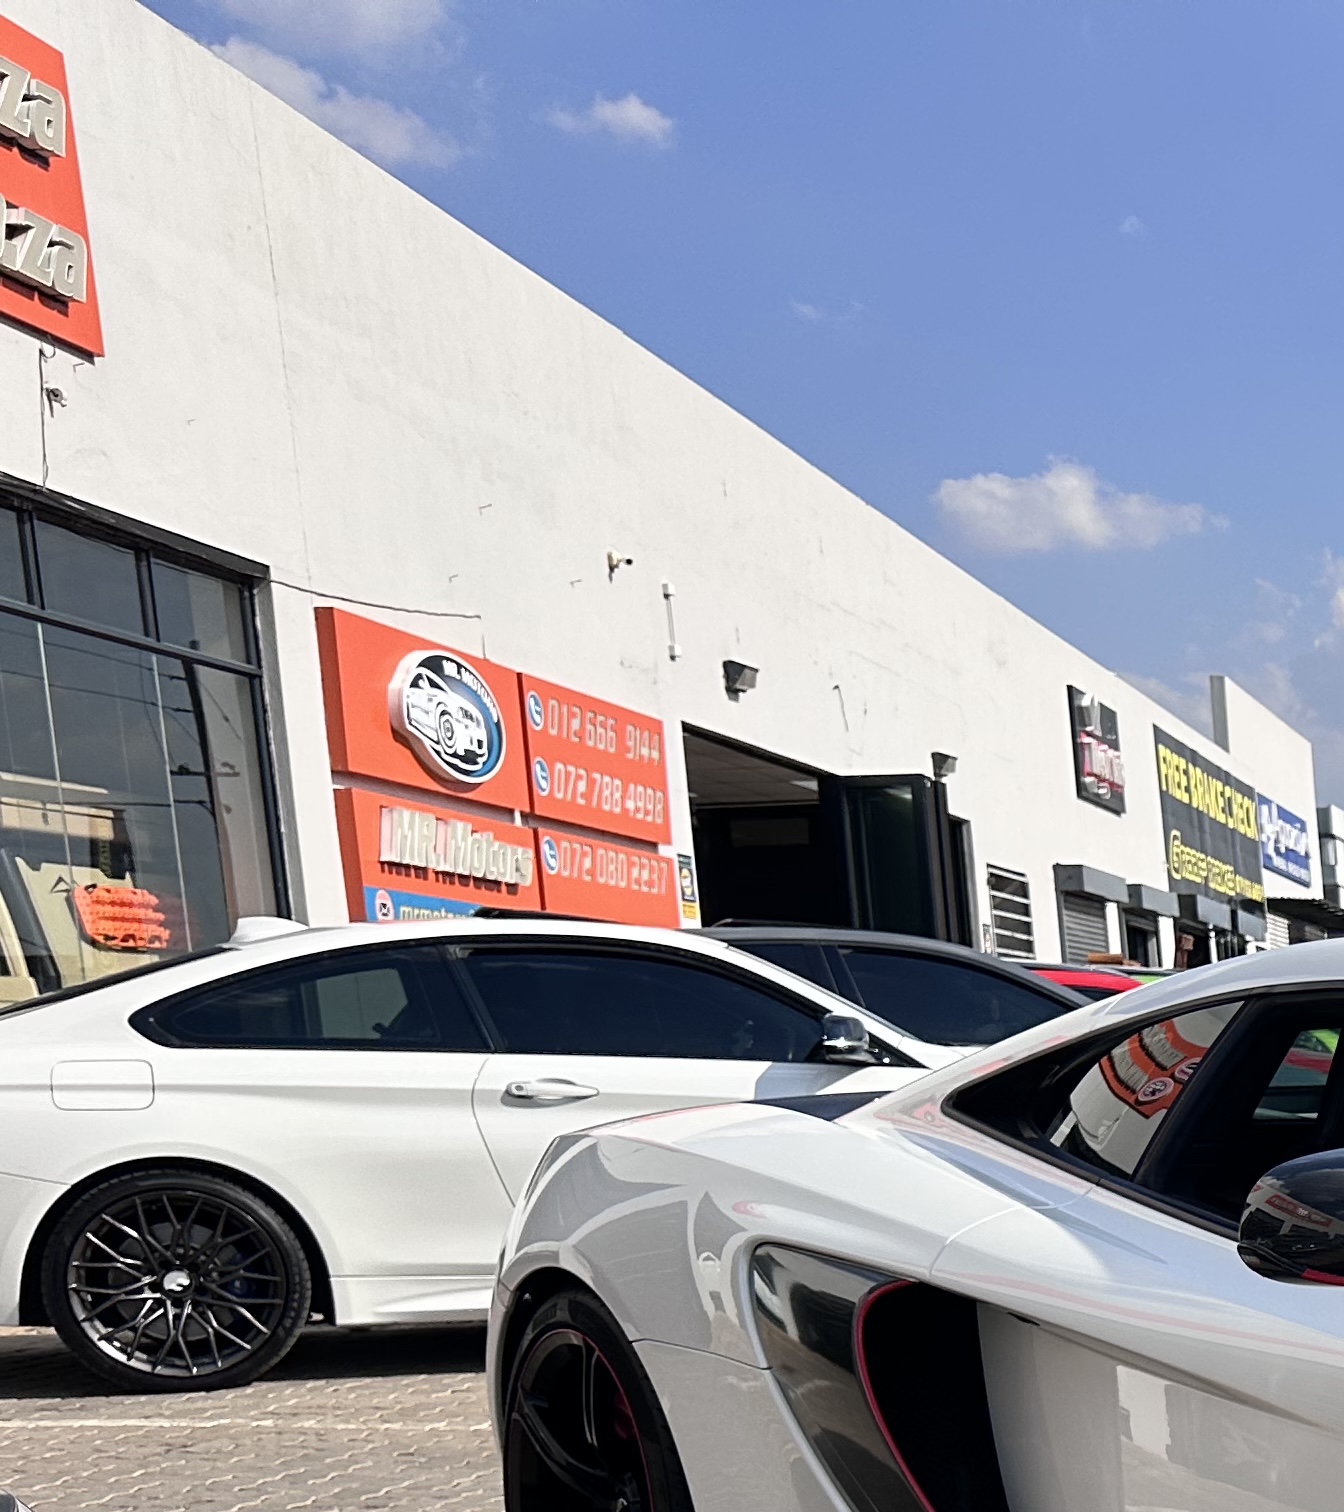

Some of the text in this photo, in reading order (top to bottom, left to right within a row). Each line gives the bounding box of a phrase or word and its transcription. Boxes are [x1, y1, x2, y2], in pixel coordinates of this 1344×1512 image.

[547, 697, 662, 766] 012 666 9144
[554, 761, 665, 825] 072 788 4998
[1157, 743, 1190, 805] FREE
[1188, 762, 1228, 825] BRAKE
[1225, 785, 1259, 842] CHECK
[440, 819, 533, 887] Motors
[560, 840, 593, 882] 072
[596, 847, 628, 888] 080
[631, 855, 669, 896] 2237
